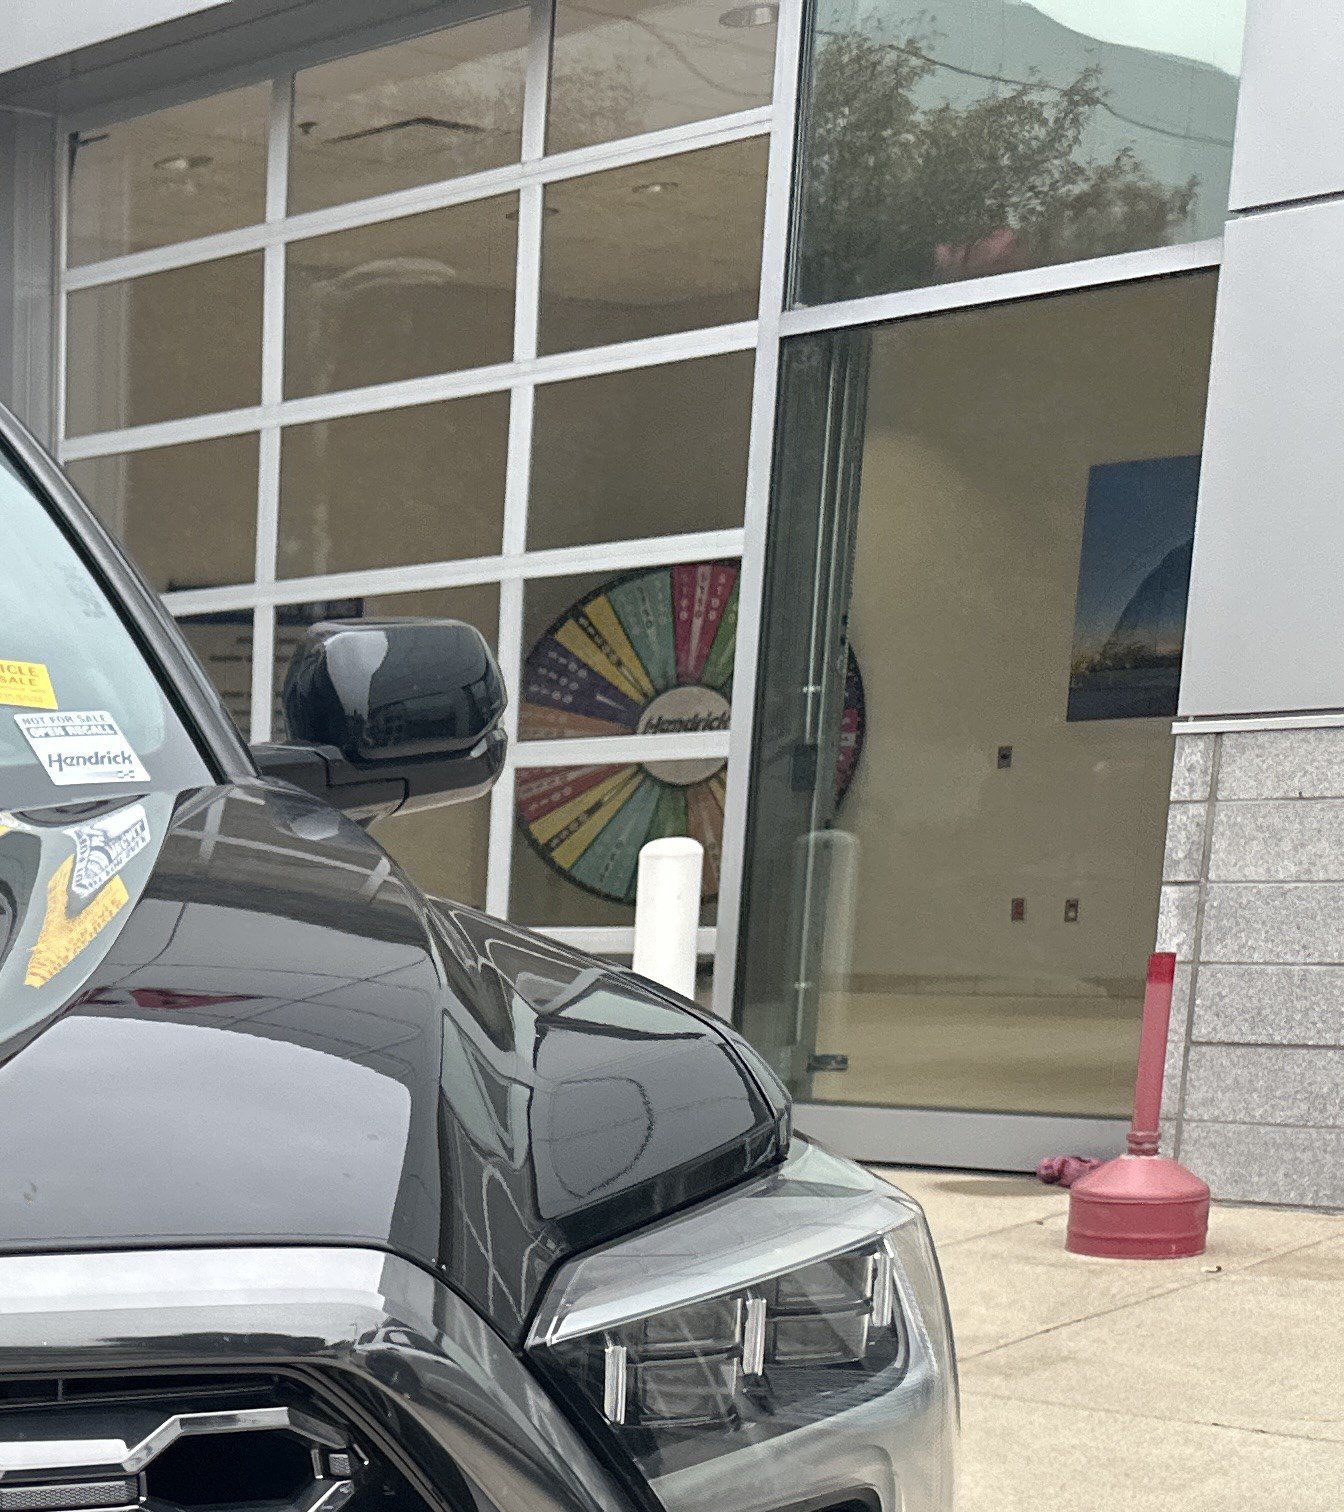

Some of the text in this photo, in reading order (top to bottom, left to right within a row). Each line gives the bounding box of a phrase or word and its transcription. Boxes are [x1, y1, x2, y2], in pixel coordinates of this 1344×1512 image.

[22, 714, 106, 726] NOT FOR SALE
[29, 724, 116, 738] OPEN RECALL
[48, 750, 133, 772] Hendrick
